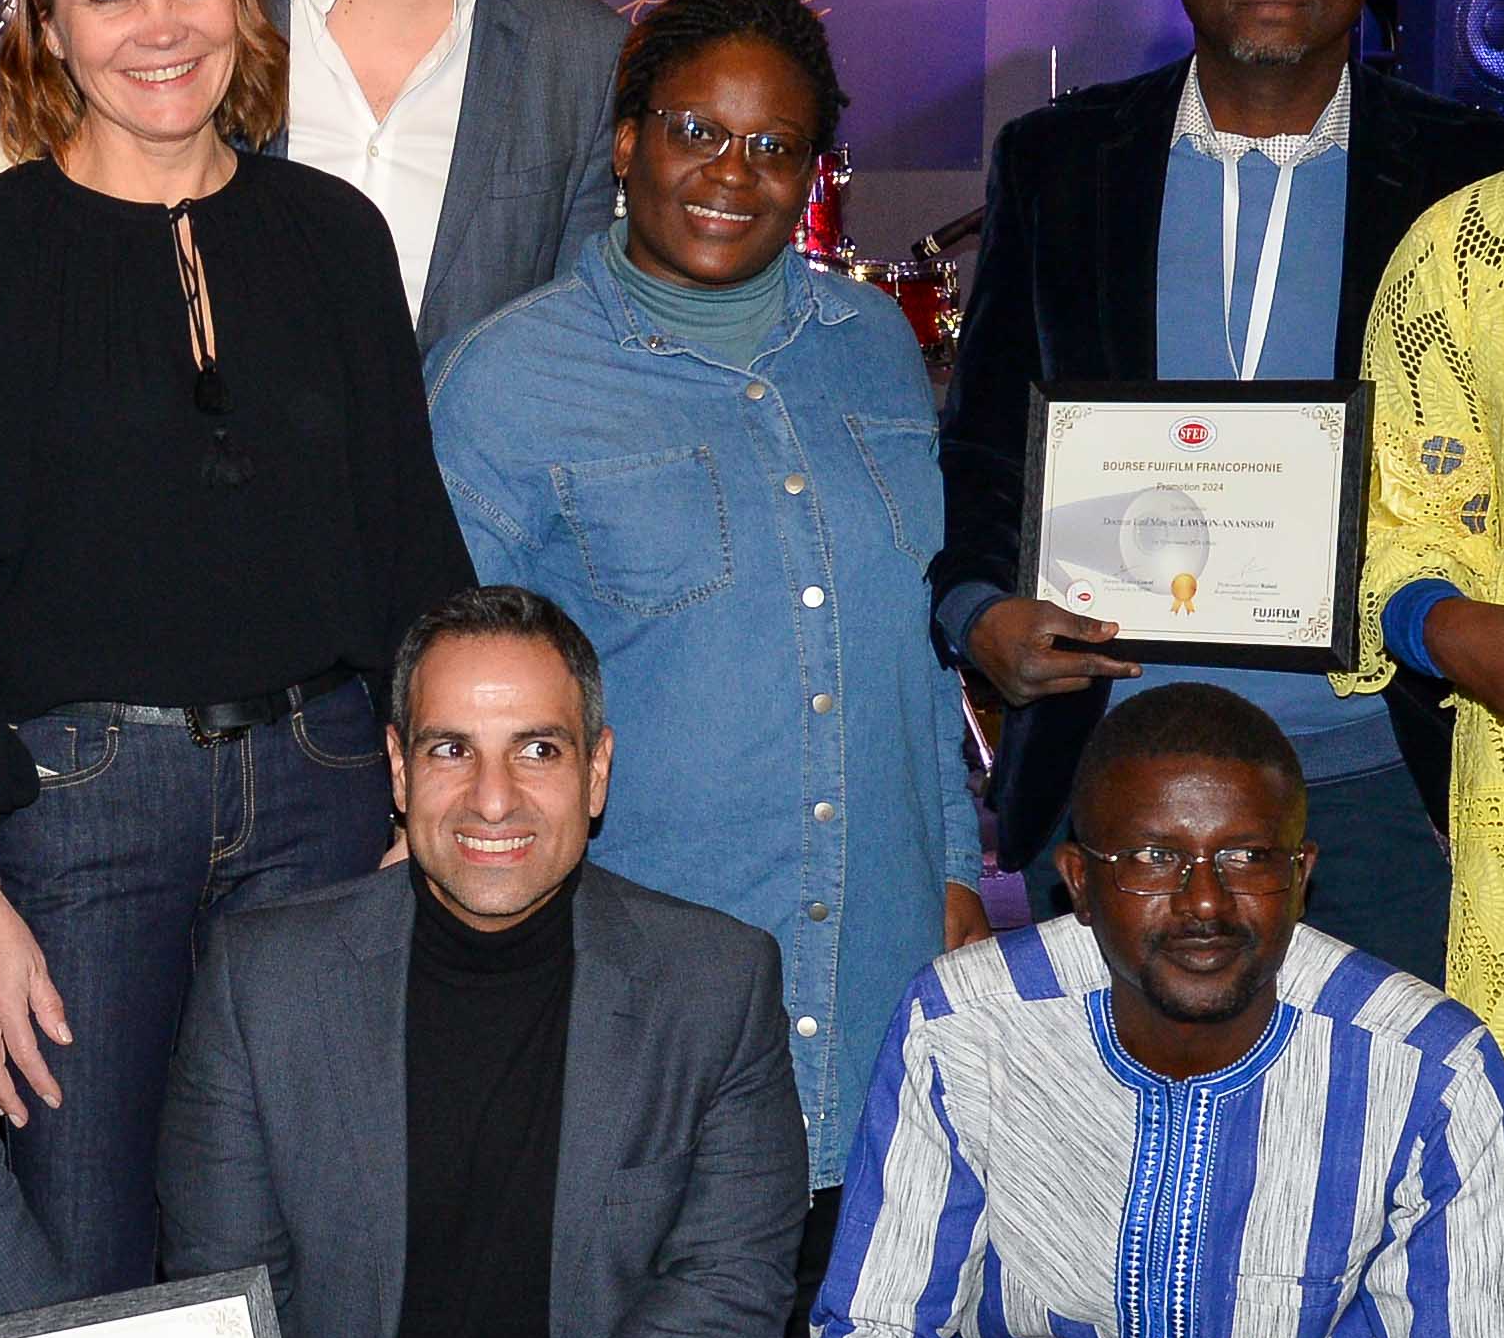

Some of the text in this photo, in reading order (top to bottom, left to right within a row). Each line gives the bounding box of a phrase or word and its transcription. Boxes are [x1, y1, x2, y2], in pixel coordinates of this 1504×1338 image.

[1179, 427, 1208, 441] SFED
[1103, 461, 1283, 473] BOURSE FUJIFILM FRANCOPHONIE
[1157, 482, 1224, 492] Promotion 2024
[1253, 607, 1300, 619] FUJIFILM
